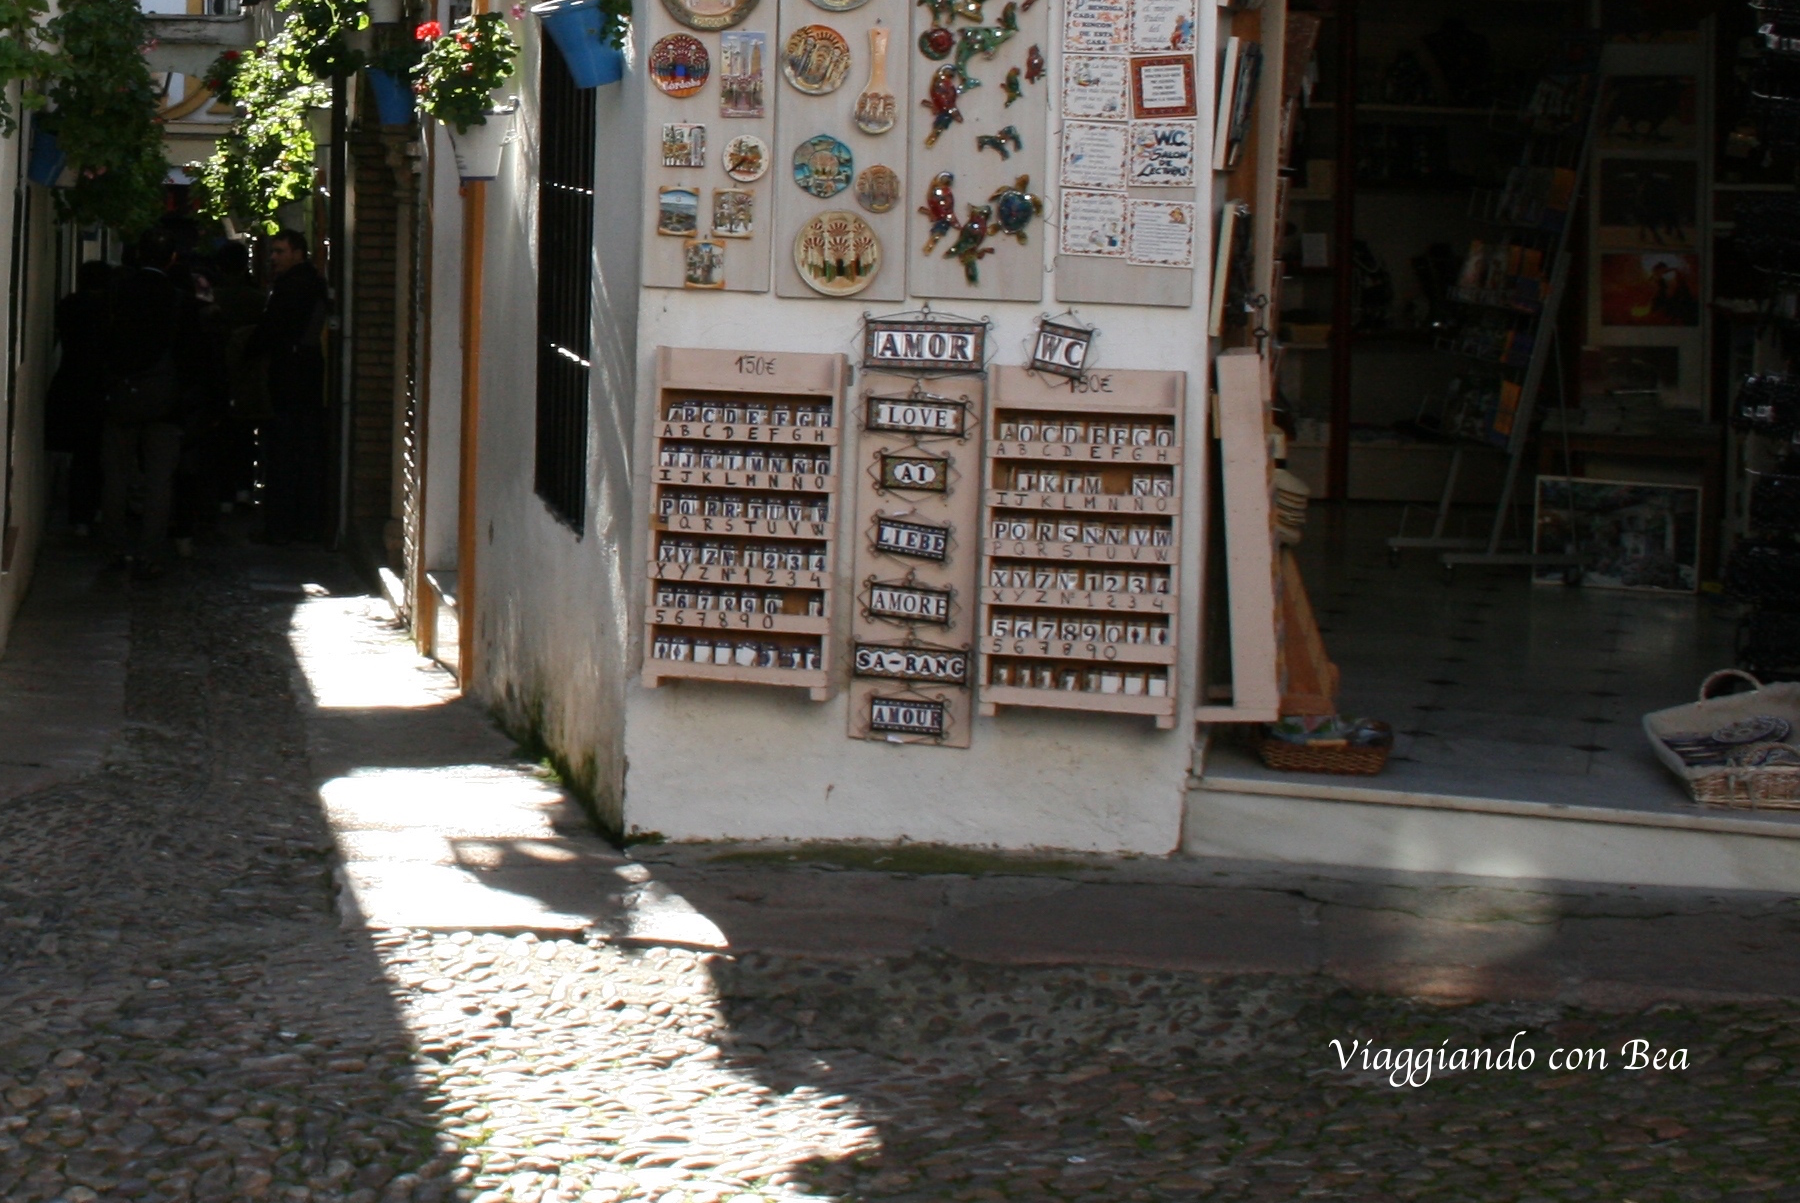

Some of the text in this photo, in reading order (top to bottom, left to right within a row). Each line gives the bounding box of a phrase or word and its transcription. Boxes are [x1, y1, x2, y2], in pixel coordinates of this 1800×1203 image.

[879, 333, 970, 361] AMOR
[1041, 332, 1083, 366] WC
[888, 406, 948, 429] LOVE
[664, 425, 824, 441] A B C D E F G H
[997, 444, 1166, 461] A B C D E F G H
[659, 470, 671, 480] I
[681, 471, 692, 482] J
[703, 472, 711, 483] K
[725, 474, 736, 485] L
[747, 473, 756, 486] M
[769, 475, 778, 488] N
[815, 476, 824, 488] O
[901, 466, 926, 481] AI
[680, 516, 824, 536] Q R S T U V W
[879, 527, 944, 551] LIEBE
[655, 563, 666, 578] X
[679, 564, 690, 575] Y
[700, 568, 709, 580] Z
[744, 571, 750, 583] 1
[766, 571, 776, 584] 2
[787, 572, 796, 586] 3
[810, 574, 820, 587] 4
[873, 592, 947, 616] AMORE
[655, 611, 773, 629] 5 6 7 8 9 0
[858, 653, 965, 676] SA-RANG
[874, 707, 942, 727] AMOUR
